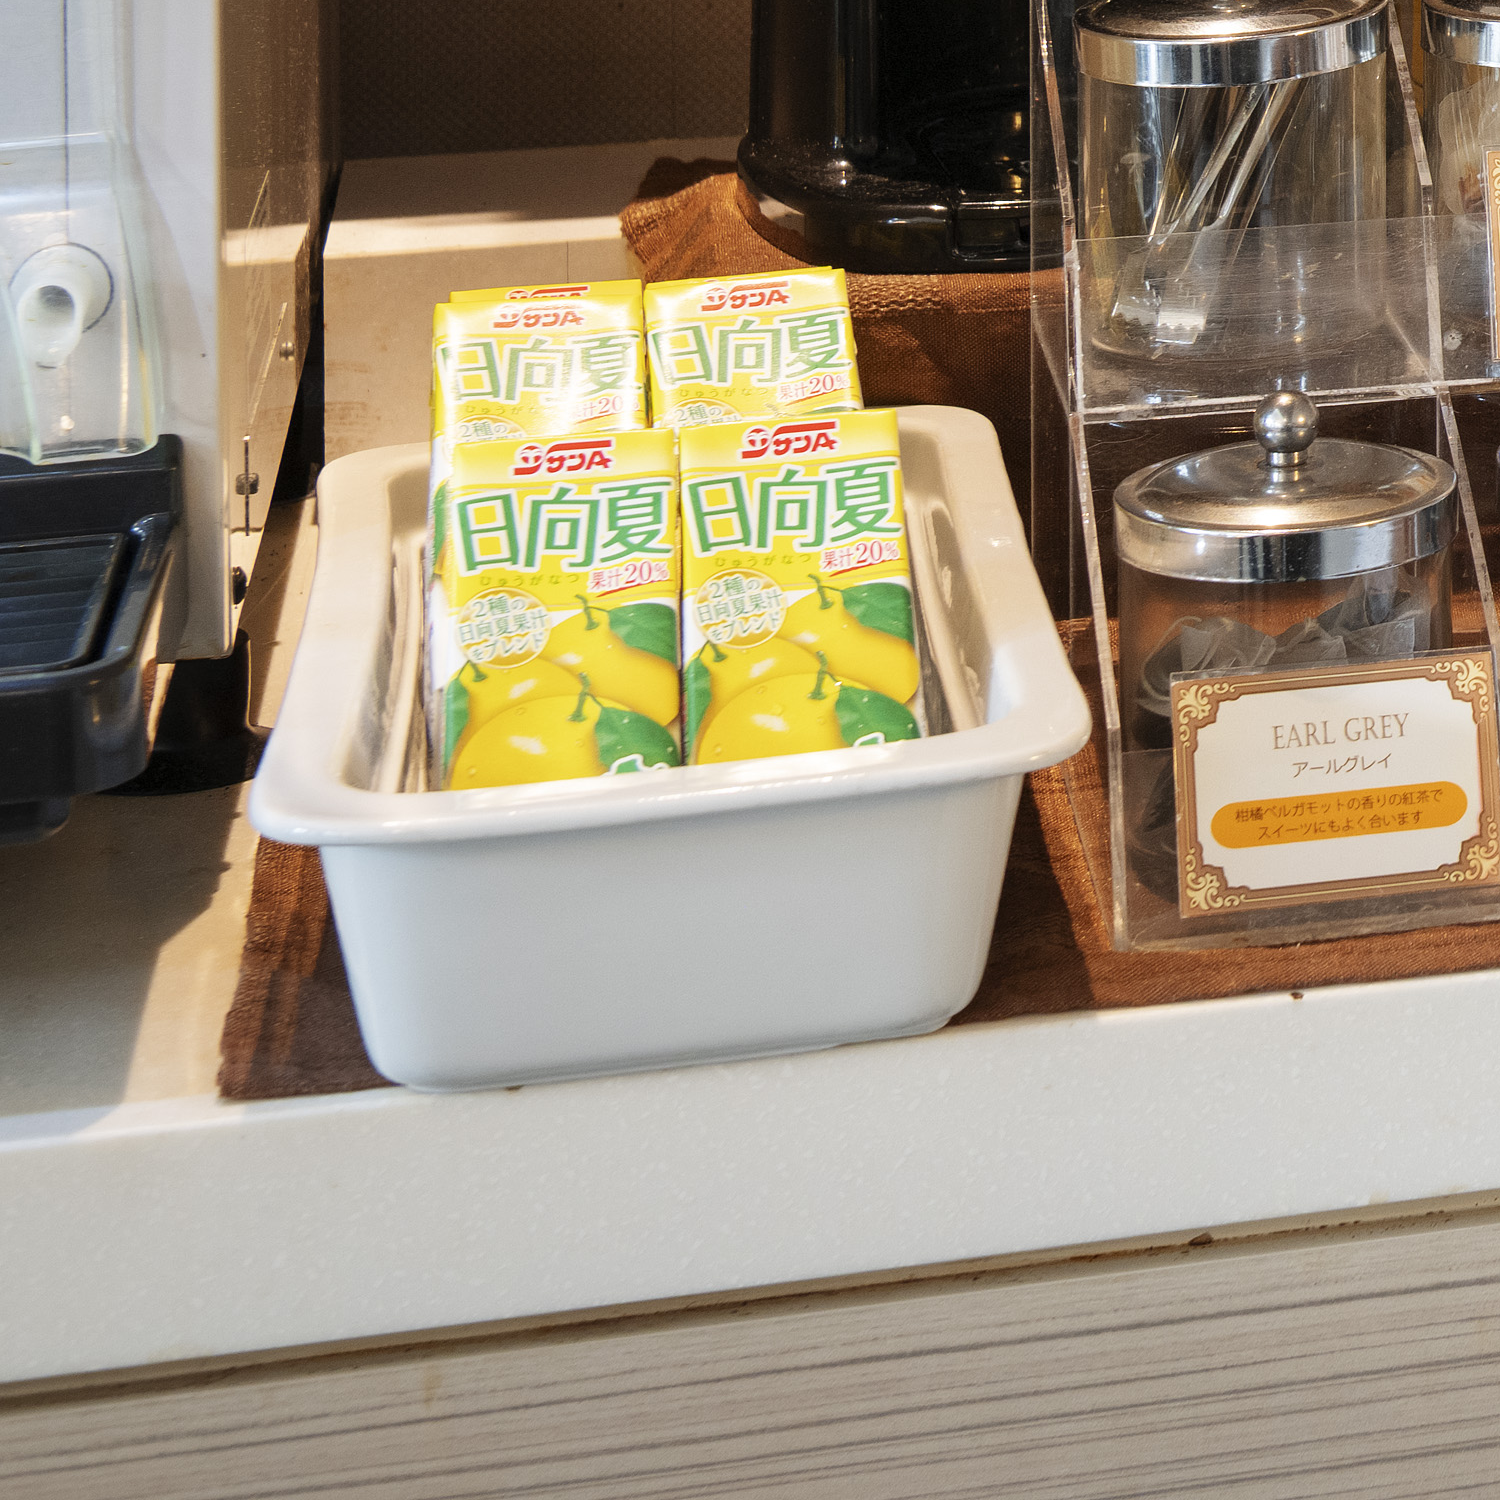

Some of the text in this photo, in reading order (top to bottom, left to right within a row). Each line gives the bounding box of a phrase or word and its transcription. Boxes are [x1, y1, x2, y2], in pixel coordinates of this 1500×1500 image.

[652, 310, 852, 384] 日向夏
[441, 334, 642, 401] 日向夏
[688, 461, 902, 553] 日向夏
[457, 481, 673, 571] 日向夏
[714, 553, 812, 567] ひゅうがなつ
[821, 539, 899, 569] 果汁20%
[590, 560, 669, 590] 果汁20%
[709, 577, 761, 600] 2種の
[472, 596, 526, 619] 2種の
[698, 590, 782, 624] 日向夏果汁
[458, 610, 547, 644] 日向夏果汁
[711, 613, 780, 641] をブレンド
[472, 632, 544, 660] をブレンド
[1272, 712, 1411, 751] EARL GREY
[1291, 752, 1394, 779] アールグレイ
[1235, 788, 1444, 823] 柑橘ベルガモットの香りの紅茶で
[1257, 810, 1424, 841] スイーツにもよく合います
